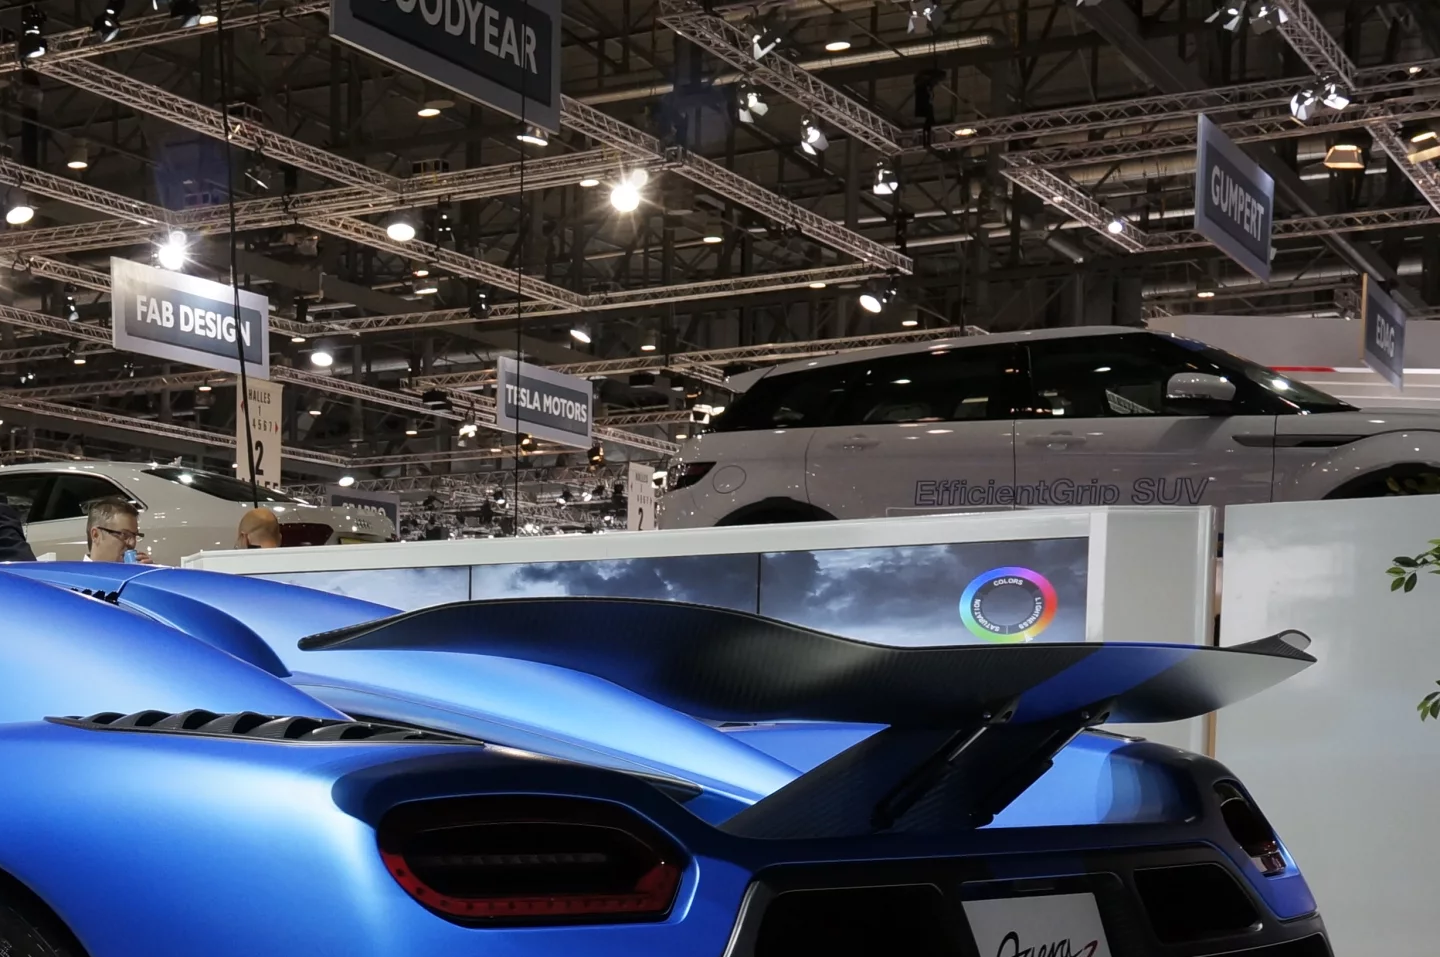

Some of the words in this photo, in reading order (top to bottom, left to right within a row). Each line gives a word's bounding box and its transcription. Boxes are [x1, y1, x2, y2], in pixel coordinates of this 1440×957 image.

[380, 0, 538, 75] ODYEAR
[1210, 164, 1265, 242] GUMPERT
[136, 294, 175, 328] FAB
[179, 304, 251, 346] DESIGN
[1375, 314, 1396, 358] EDAG
[543, 393, 588, 423] MOTORS
[255, 440, 265, 477] 2
[914, 477, 1121, 507] EfficientGrip
[1130, 477, 1210, 505] SUV
[993, 577, 1024, 587] COLORS
[1018, 596, 1043, 630] LIGHTNESS
